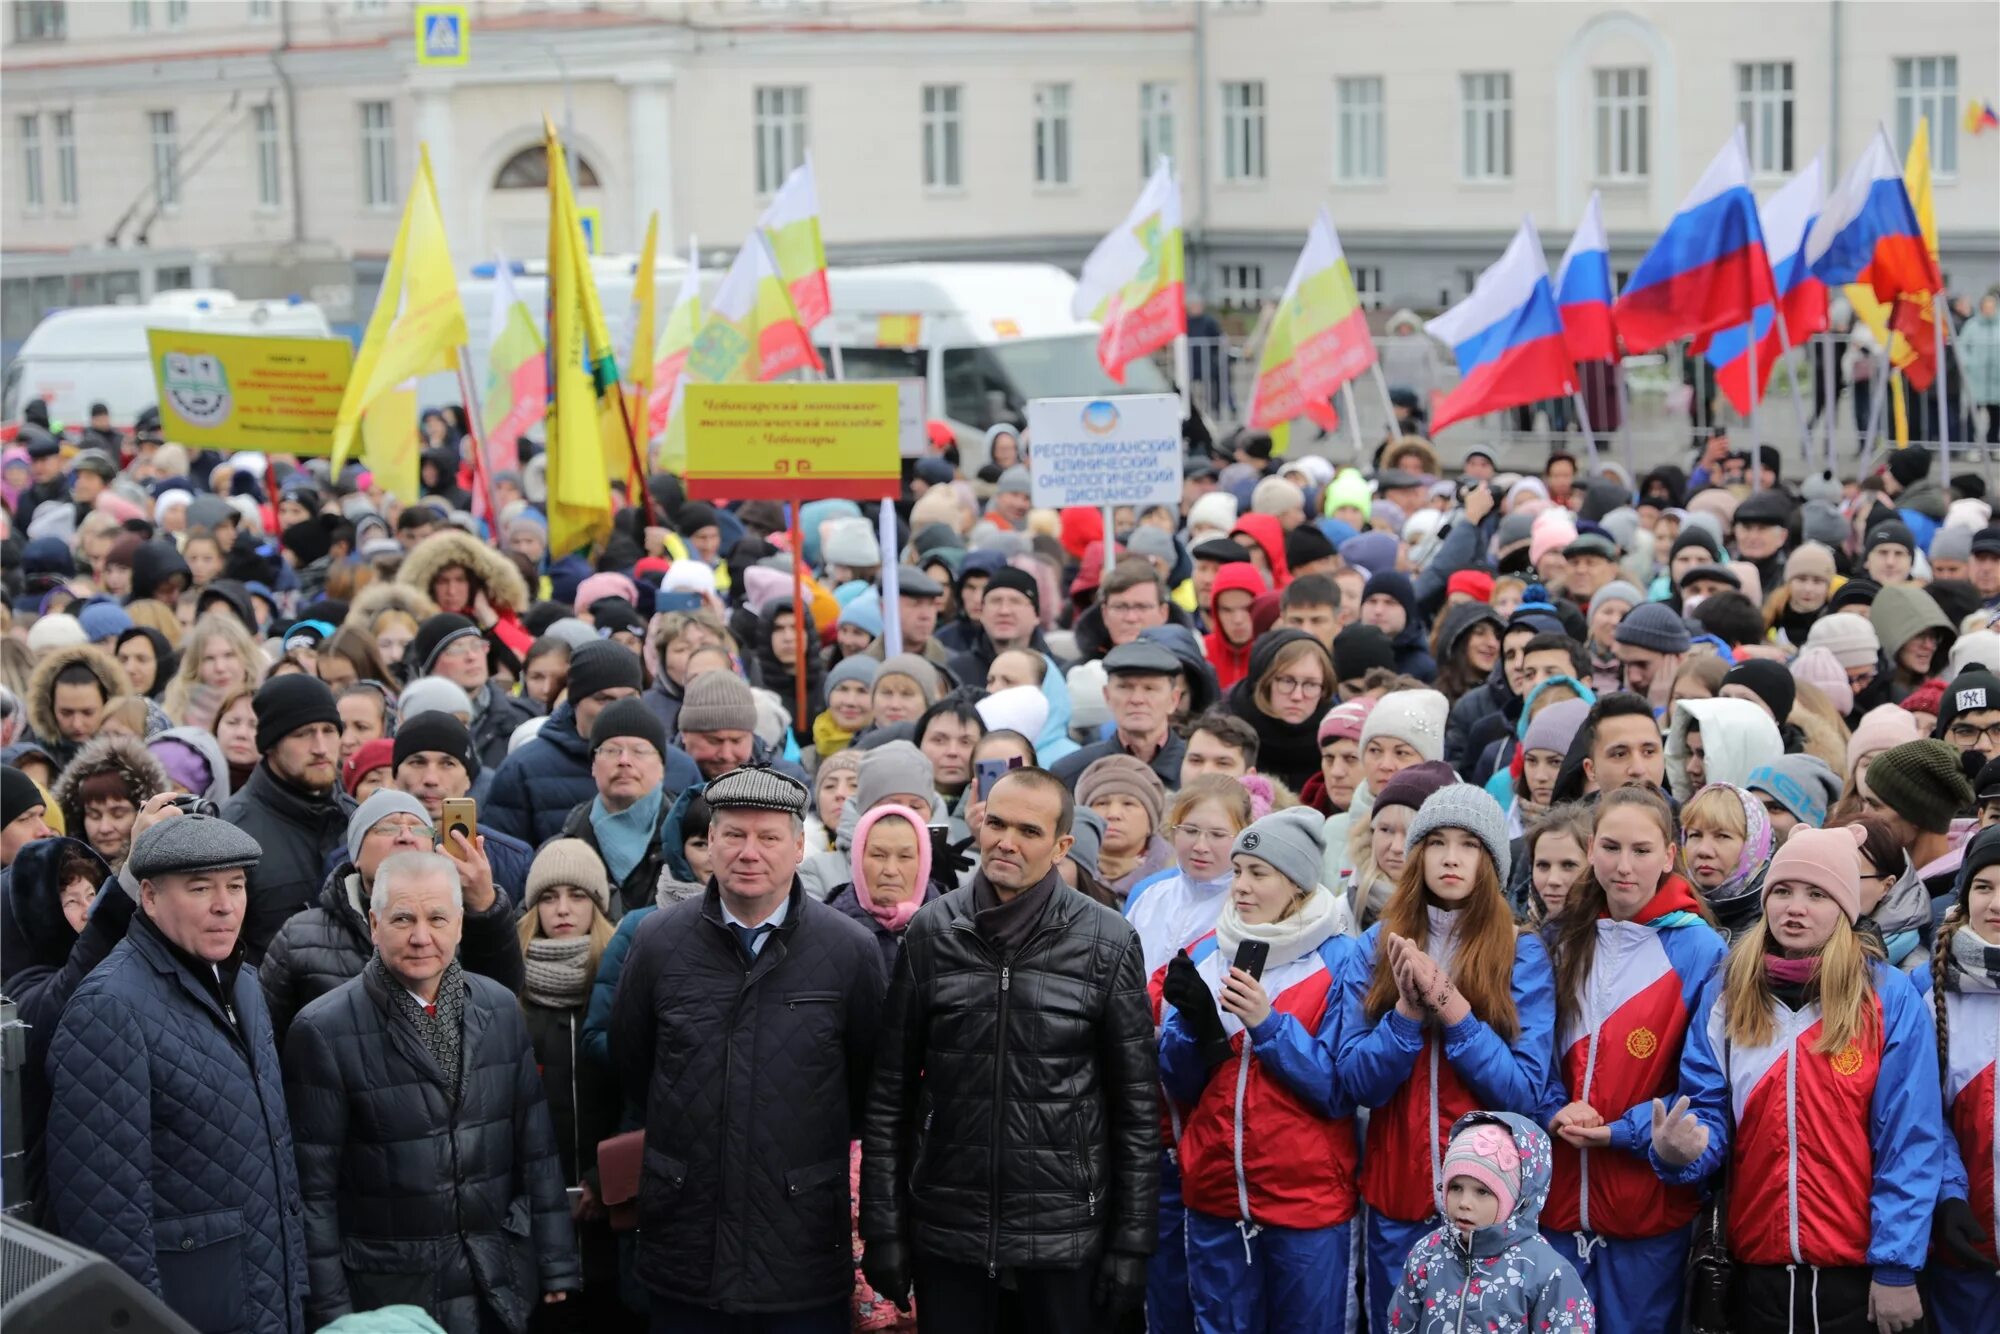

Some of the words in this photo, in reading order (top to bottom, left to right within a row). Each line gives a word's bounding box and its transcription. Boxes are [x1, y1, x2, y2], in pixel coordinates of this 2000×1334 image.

[1033, 437, 1176, 458] РЕСПУБЛИКАНСКИЙ
[1053, 453, 1159, 471] КЛИНИЧЕСКИЙ
[1039, 467, 1175, 488] ОНКОЛОГИЧЕСКИЙ
[1064, 486, 1154, 503] ДИСПАНСЕР
